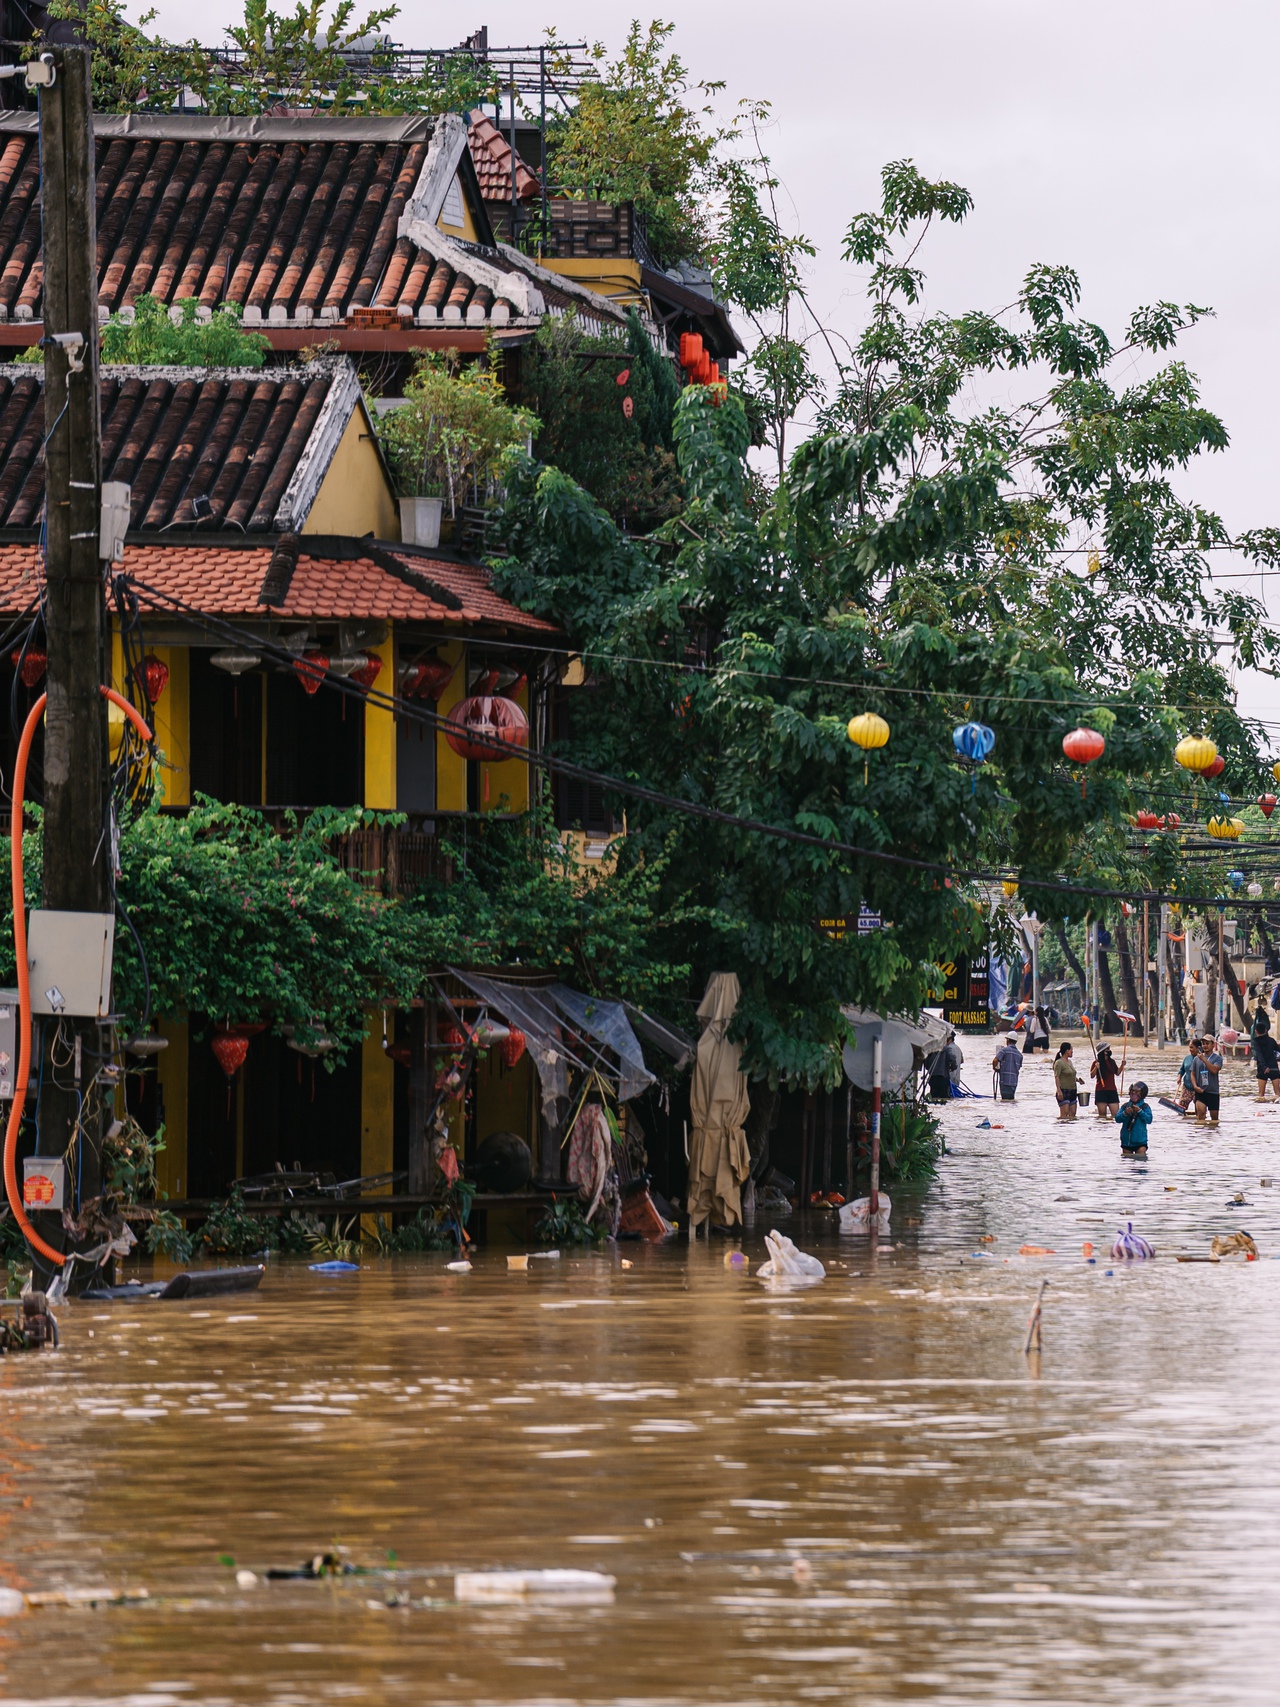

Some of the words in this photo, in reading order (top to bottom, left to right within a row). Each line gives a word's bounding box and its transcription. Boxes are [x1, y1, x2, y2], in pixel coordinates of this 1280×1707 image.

[860, 919, 880, 927] 45.000
[949, 1011, 963, 1025] FOOT
[963, 1011, 987, 1025] MASSAGE
